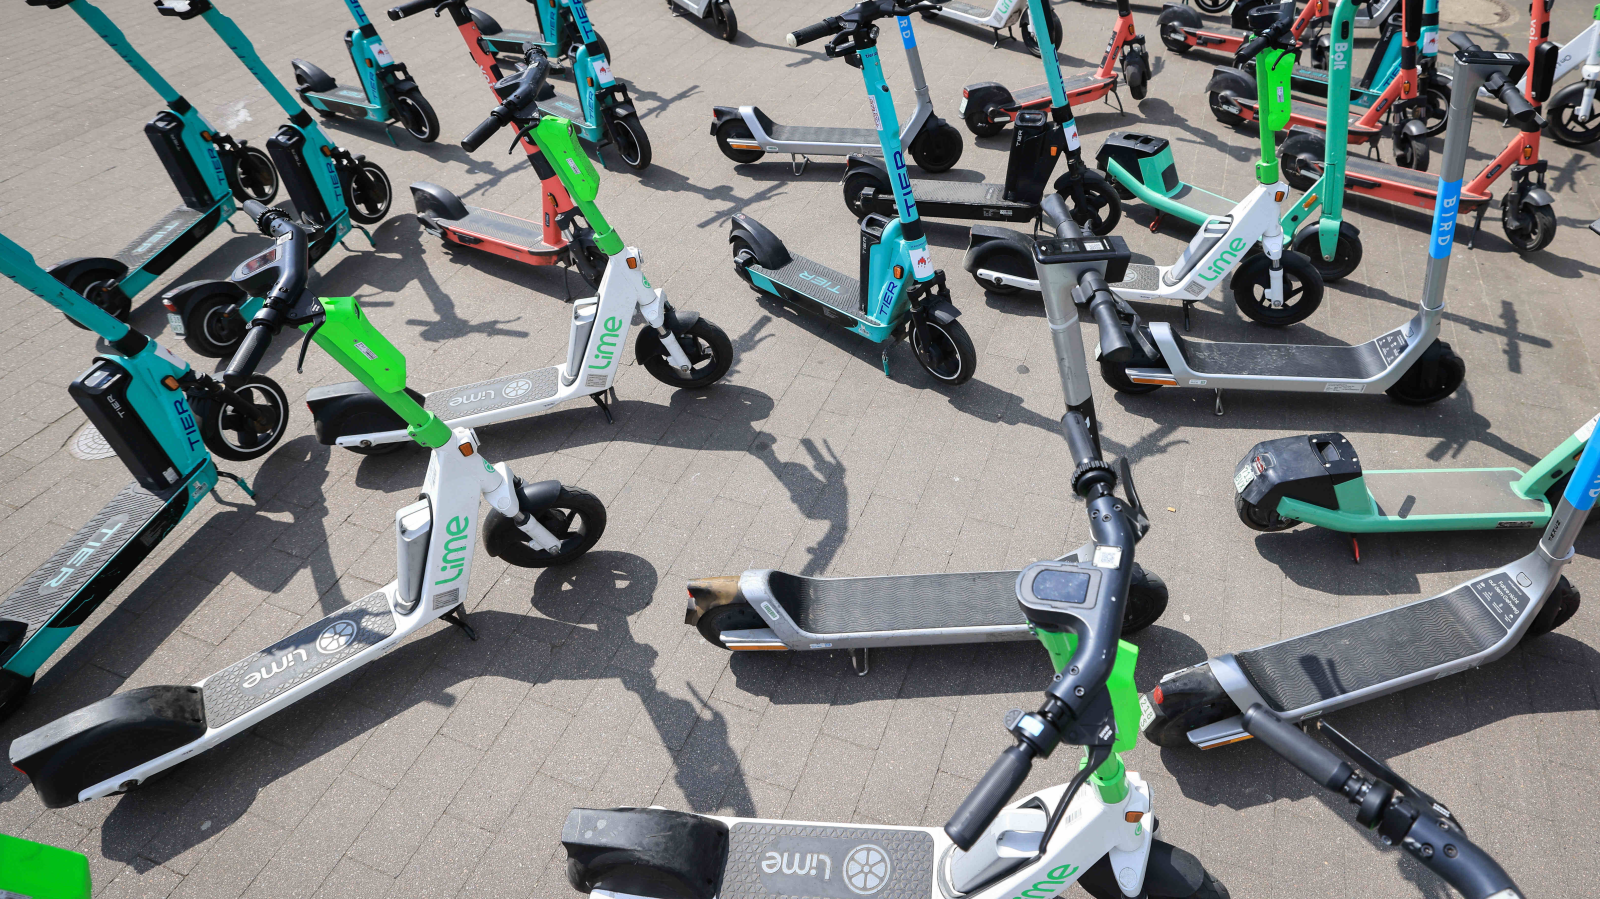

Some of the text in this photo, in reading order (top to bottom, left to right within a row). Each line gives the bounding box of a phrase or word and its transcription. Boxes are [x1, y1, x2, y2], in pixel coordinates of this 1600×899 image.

[900, 19, 911, 39] RD
[1331, 42, 1348, 70] Bolt
[1383, 62, 1402, 87] TIE
[208, 148, 225, 186] TIER
[326, 162, 345, 202] TIER
[893, 150, 916, 217] TIER
[1438, 195, 1457, 246] BIRD
[1197, 237, 1247, 282] Lime
[799, 270, 841, 294] TIER
[879, 280, 898, 316] TIER
[588, 316, 622, 370] Lime
[106, 394, 125, 419] TIER
[449, 389, 495, 407] Lime
[173, 397, 200, 452] TIER
[43, 522, 123, 588] TIER
[434, 515, 470, 586] Lime
[242, 648, 308, 689] Lime
[761, 851, 831, 882] Lime
[1013, 864, 1079, 899] me
